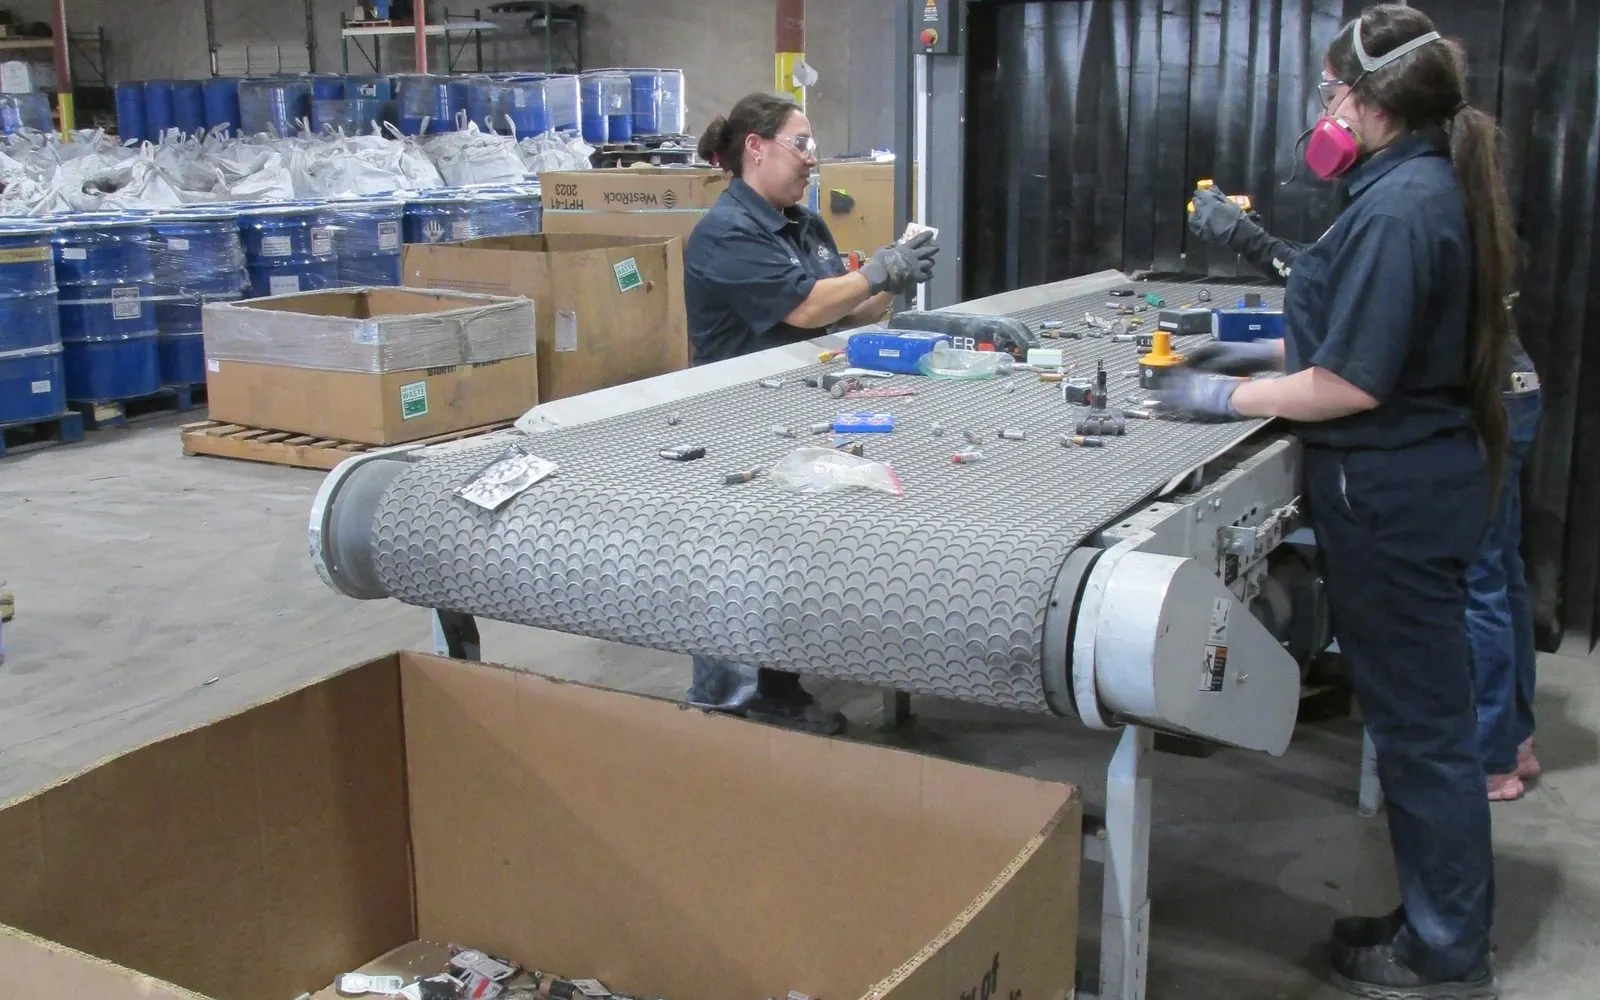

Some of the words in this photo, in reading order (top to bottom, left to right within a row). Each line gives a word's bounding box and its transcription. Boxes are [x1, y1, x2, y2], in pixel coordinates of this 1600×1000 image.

[555, 184, 577, 196] 2023
[603, 192, 658, 205] WestRock
[551, 199, 584, 210] HPT-41
[402, 388, 425, 399] WASTE
